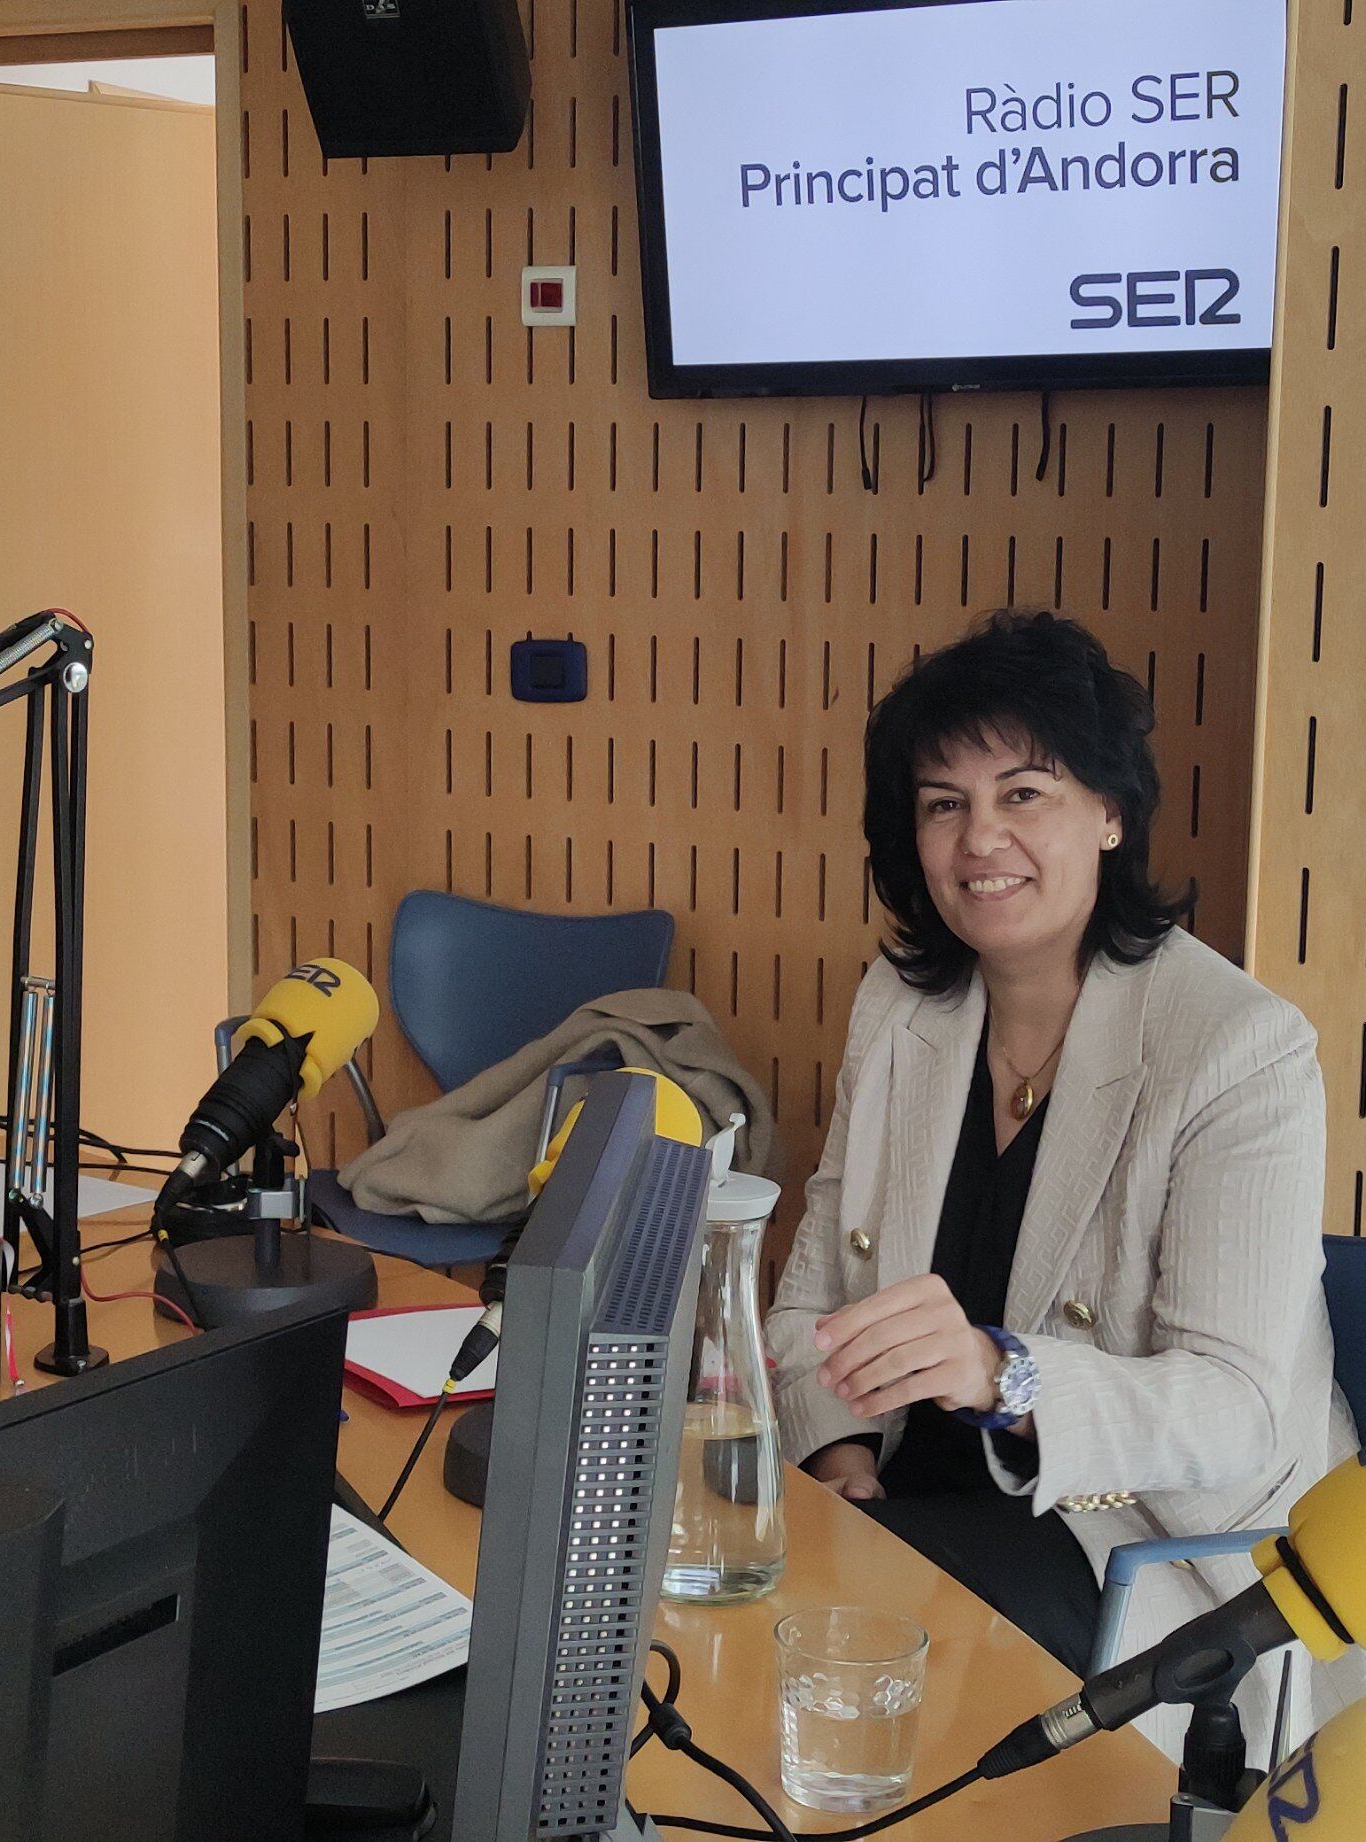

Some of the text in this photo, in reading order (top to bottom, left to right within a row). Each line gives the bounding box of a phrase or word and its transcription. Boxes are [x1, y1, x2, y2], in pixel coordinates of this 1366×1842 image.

[964, 69, 1241, 135] Ràdio SER
[739, 141, 1241, 213] Principat d’Andorra
[1069, 267, 1242, 329] SER
[283, 963, 341, 998] ER
